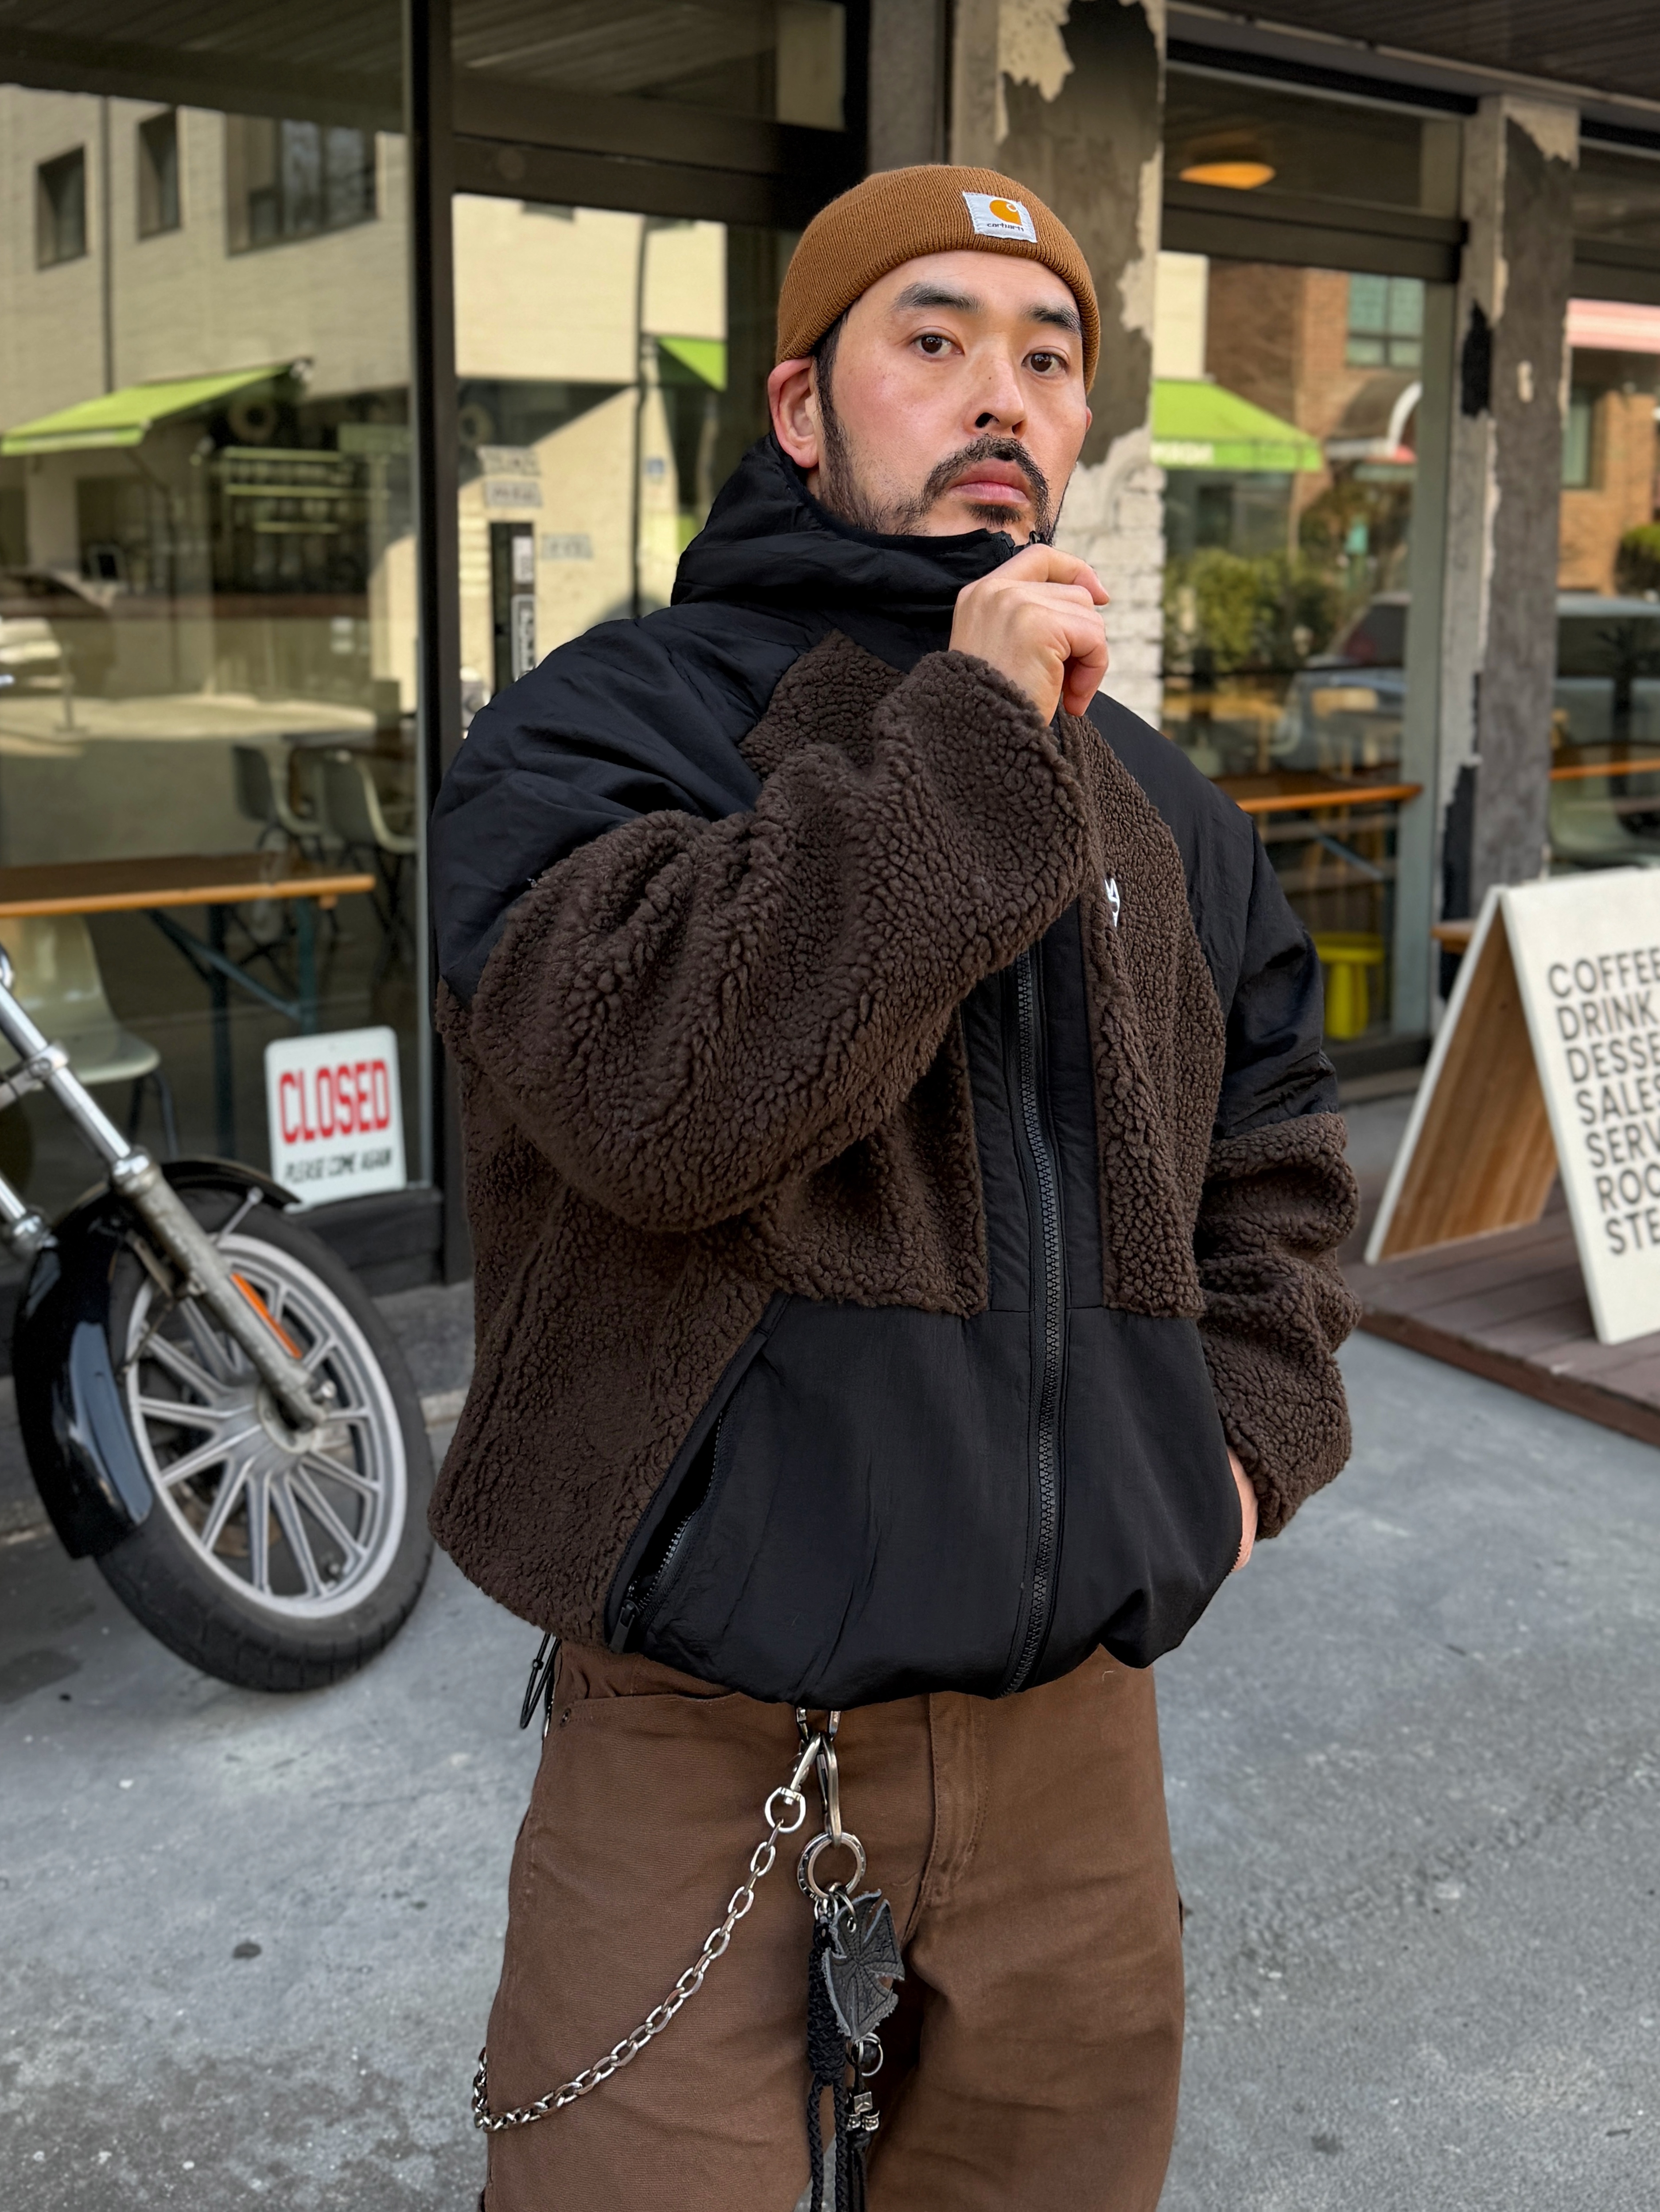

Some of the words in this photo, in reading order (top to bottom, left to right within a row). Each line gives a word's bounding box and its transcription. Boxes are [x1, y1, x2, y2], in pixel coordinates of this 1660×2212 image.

[987, 223, 1024, 231] carhartt
[1547, 947, 1660, 998] COFFEE
[1556, 990, 1659, 1041] DRINK
[1566, 1032, 1660, 1083] DESSE
[279, 1059, 391, 1145] CLOSED
[286, 1158, 324, 1184] PLEASE
[328, 1152, 356, 1177] COME
[362, 1148, 391, 1170] AGAIN
[1606, 1206, 1660, 1256] STE
